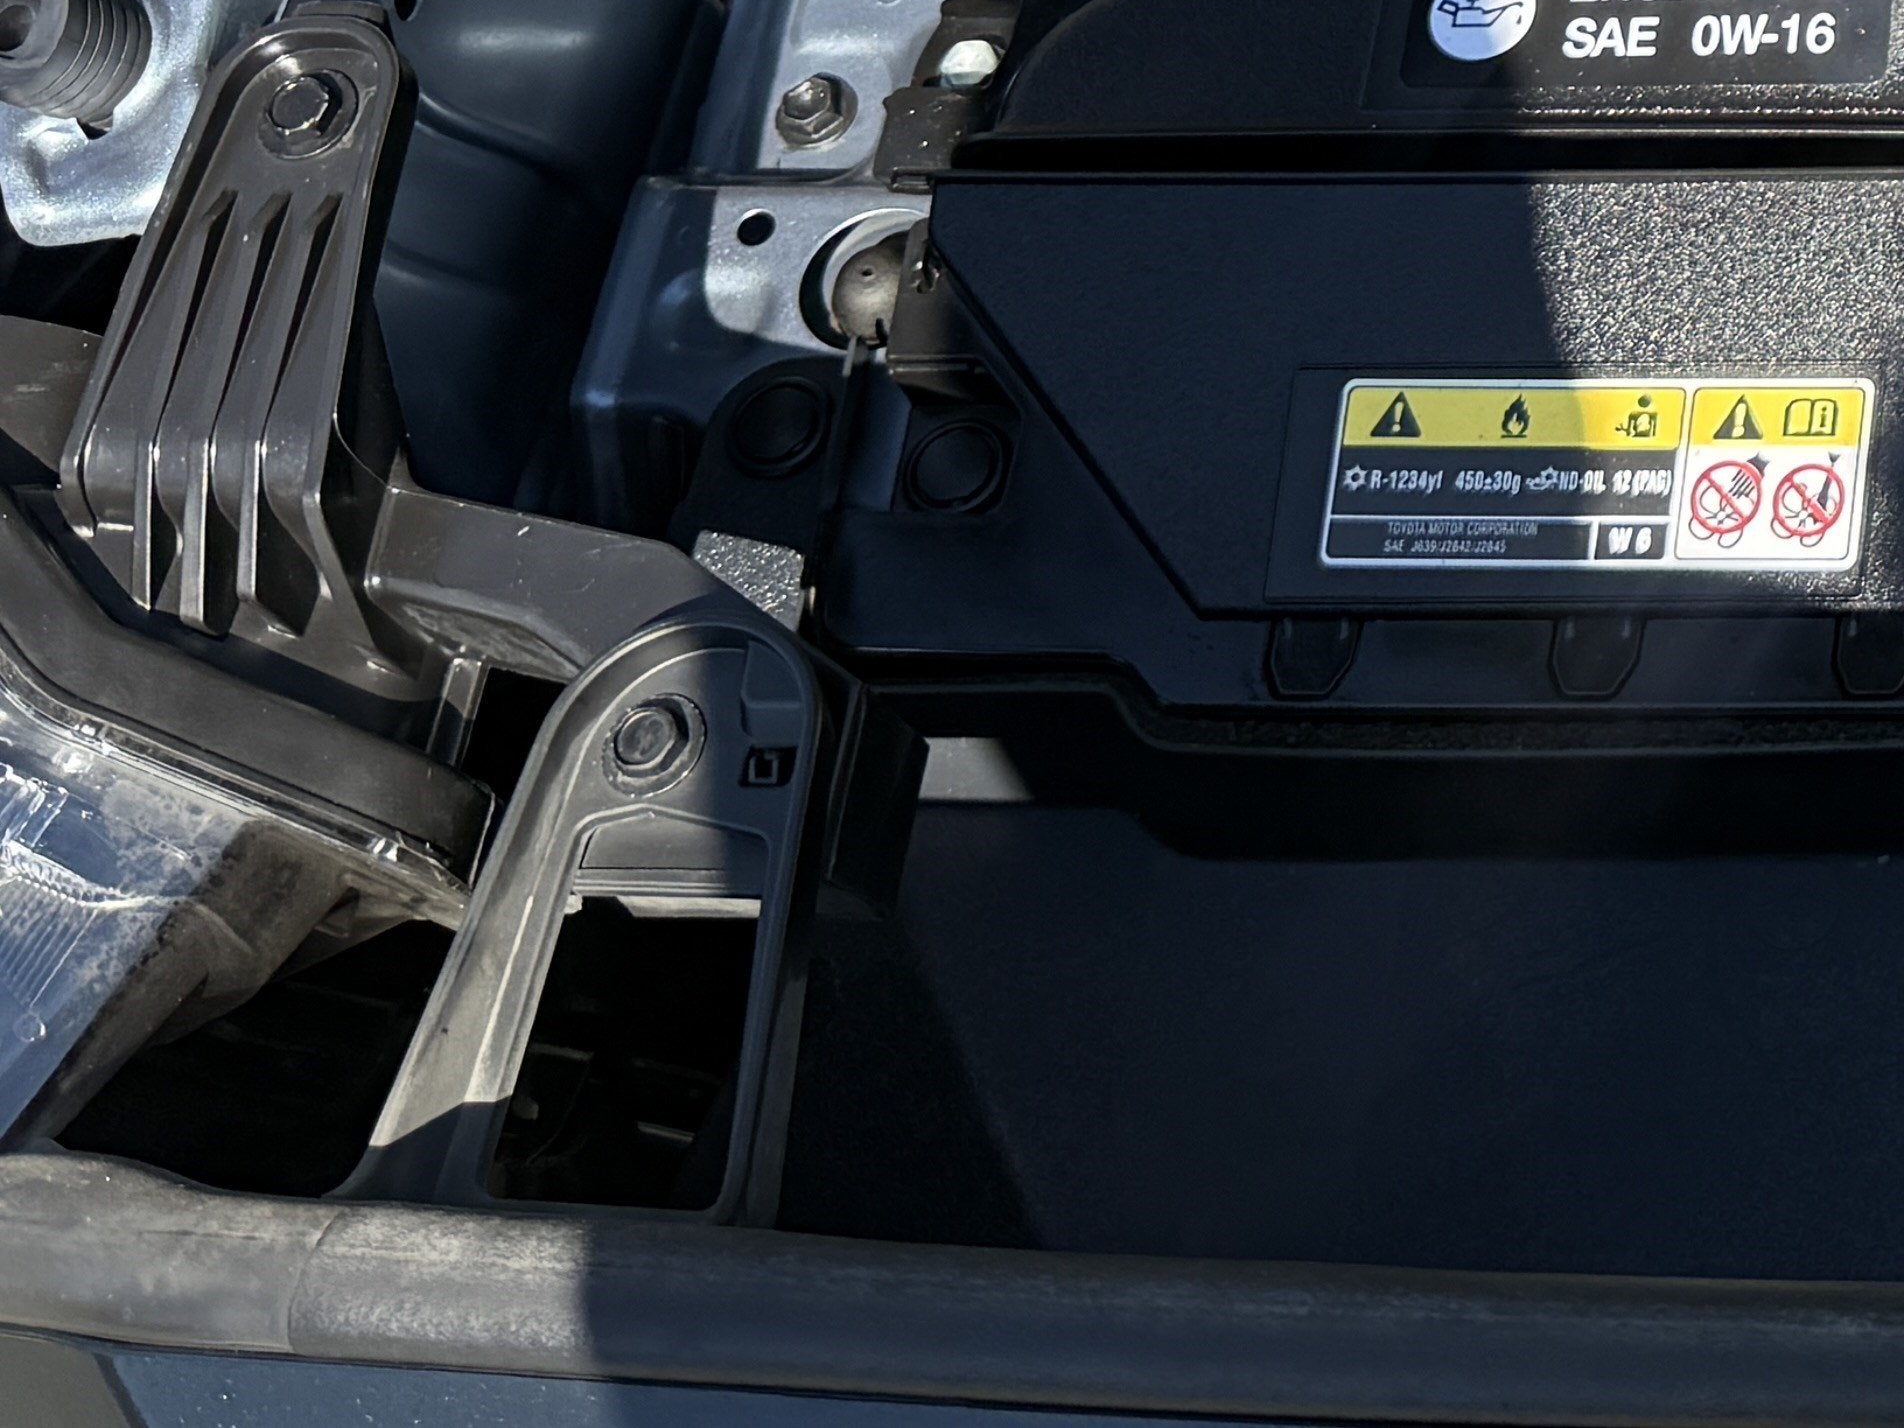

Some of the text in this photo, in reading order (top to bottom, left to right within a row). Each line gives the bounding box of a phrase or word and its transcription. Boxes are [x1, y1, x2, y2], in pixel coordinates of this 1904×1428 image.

[1562, 12, 1837, 59] SAE 0W-16
[1387, 521, 1539, 536] TOYOTA MOTOR CORPORATION
[1383, 539, 1406, 553] SAE
